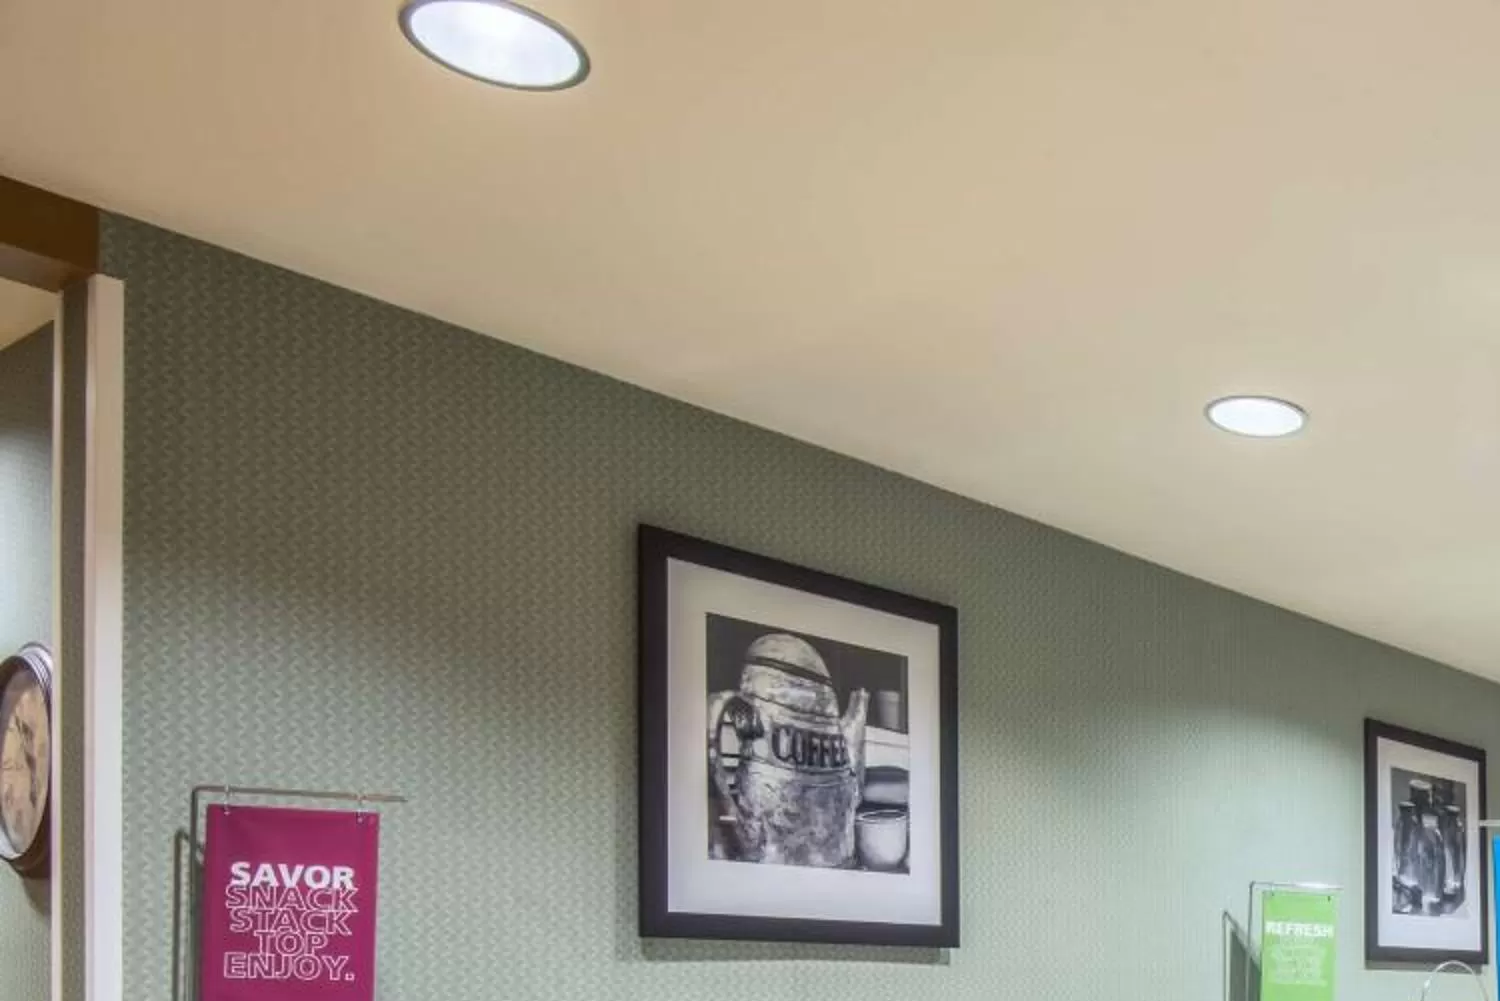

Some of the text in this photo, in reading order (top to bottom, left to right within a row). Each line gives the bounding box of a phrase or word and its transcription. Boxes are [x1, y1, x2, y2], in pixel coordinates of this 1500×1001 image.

[229, 861, 355, 890] SAVOR
[225, 884, 359, 913] SNACK
[229, 906, 353, 935] STACK
[1264, 921, 1335, 938] REFRESH
[253, 929, 329, 957] TOP
[223, 951, 355, 981] ENJOY.
